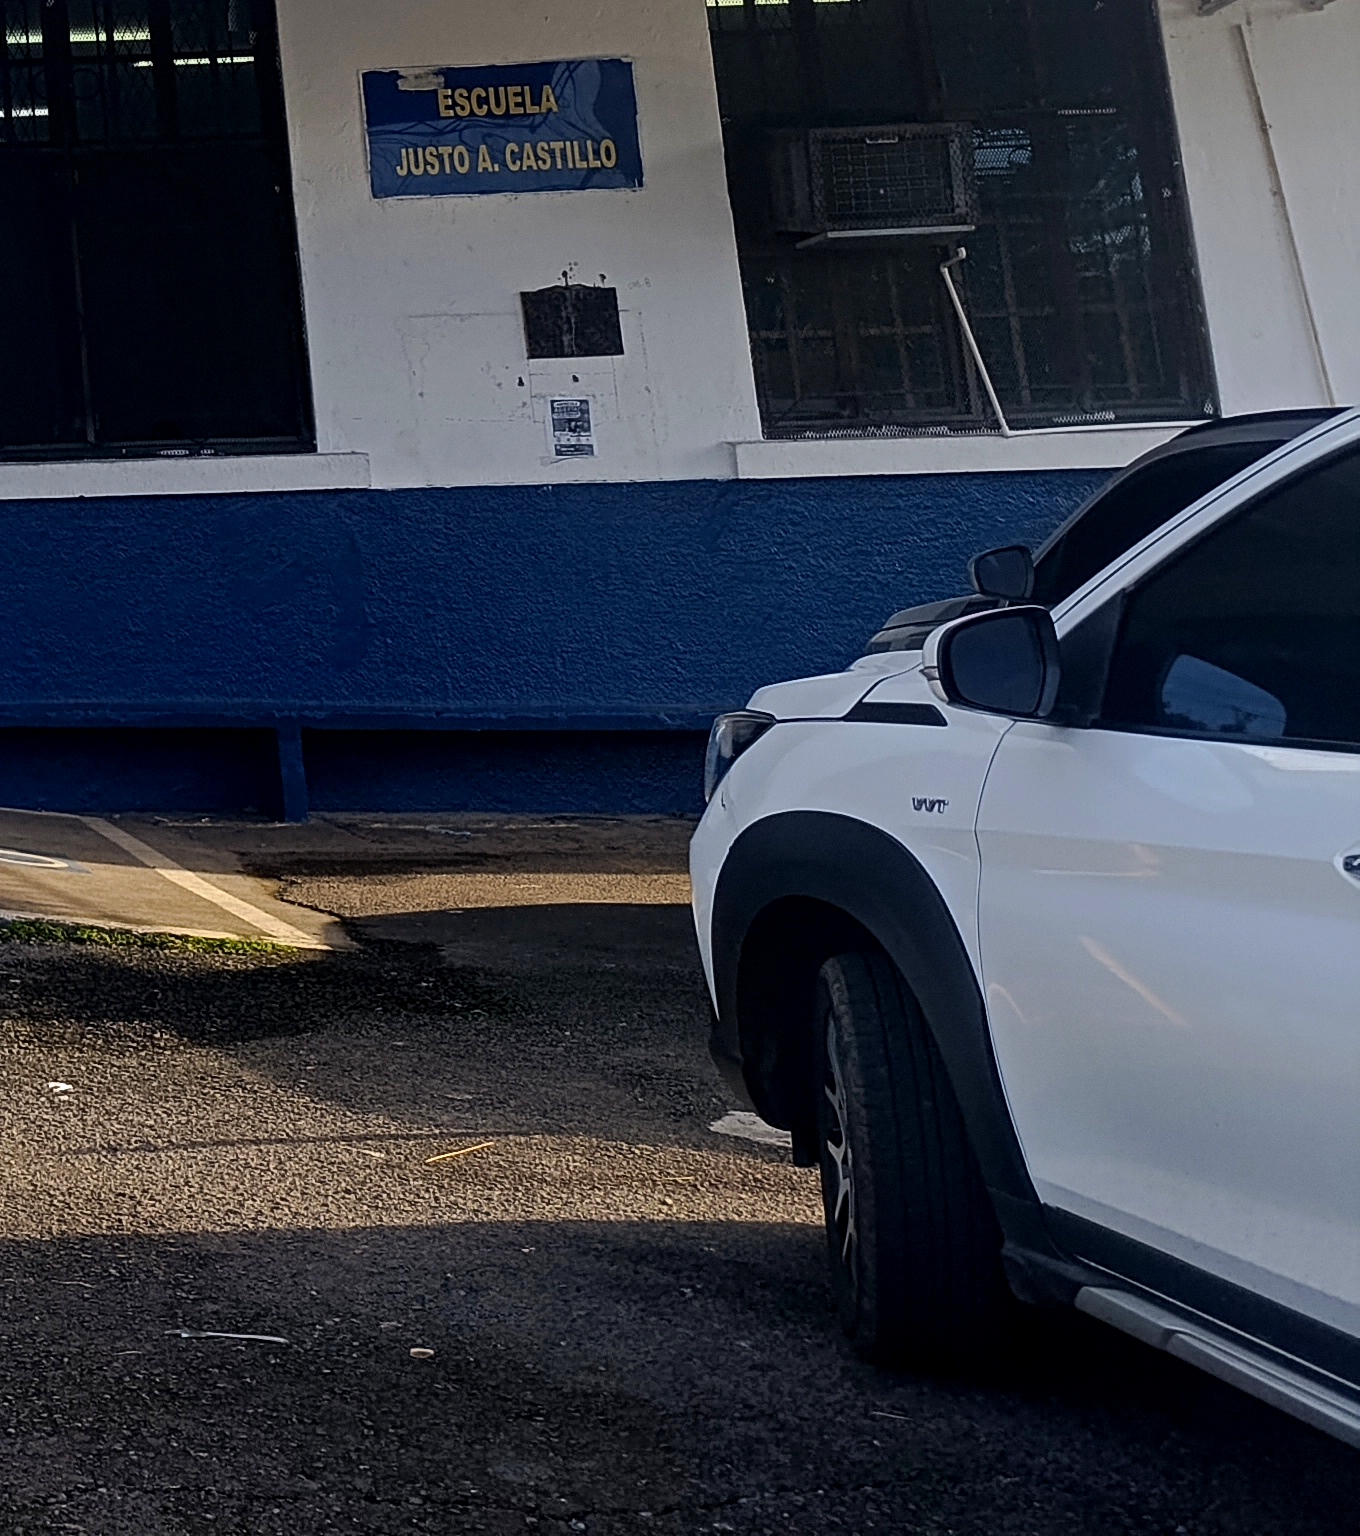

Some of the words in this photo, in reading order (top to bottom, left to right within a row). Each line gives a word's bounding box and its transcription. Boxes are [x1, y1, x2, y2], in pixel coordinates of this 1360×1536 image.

[437, 84, 559, 117] ESCUELA
[396, 145, 470, 177] JUSTO
[477, 144, 499, 173] A.
[505, 138, 617, 172] CASTILLO
